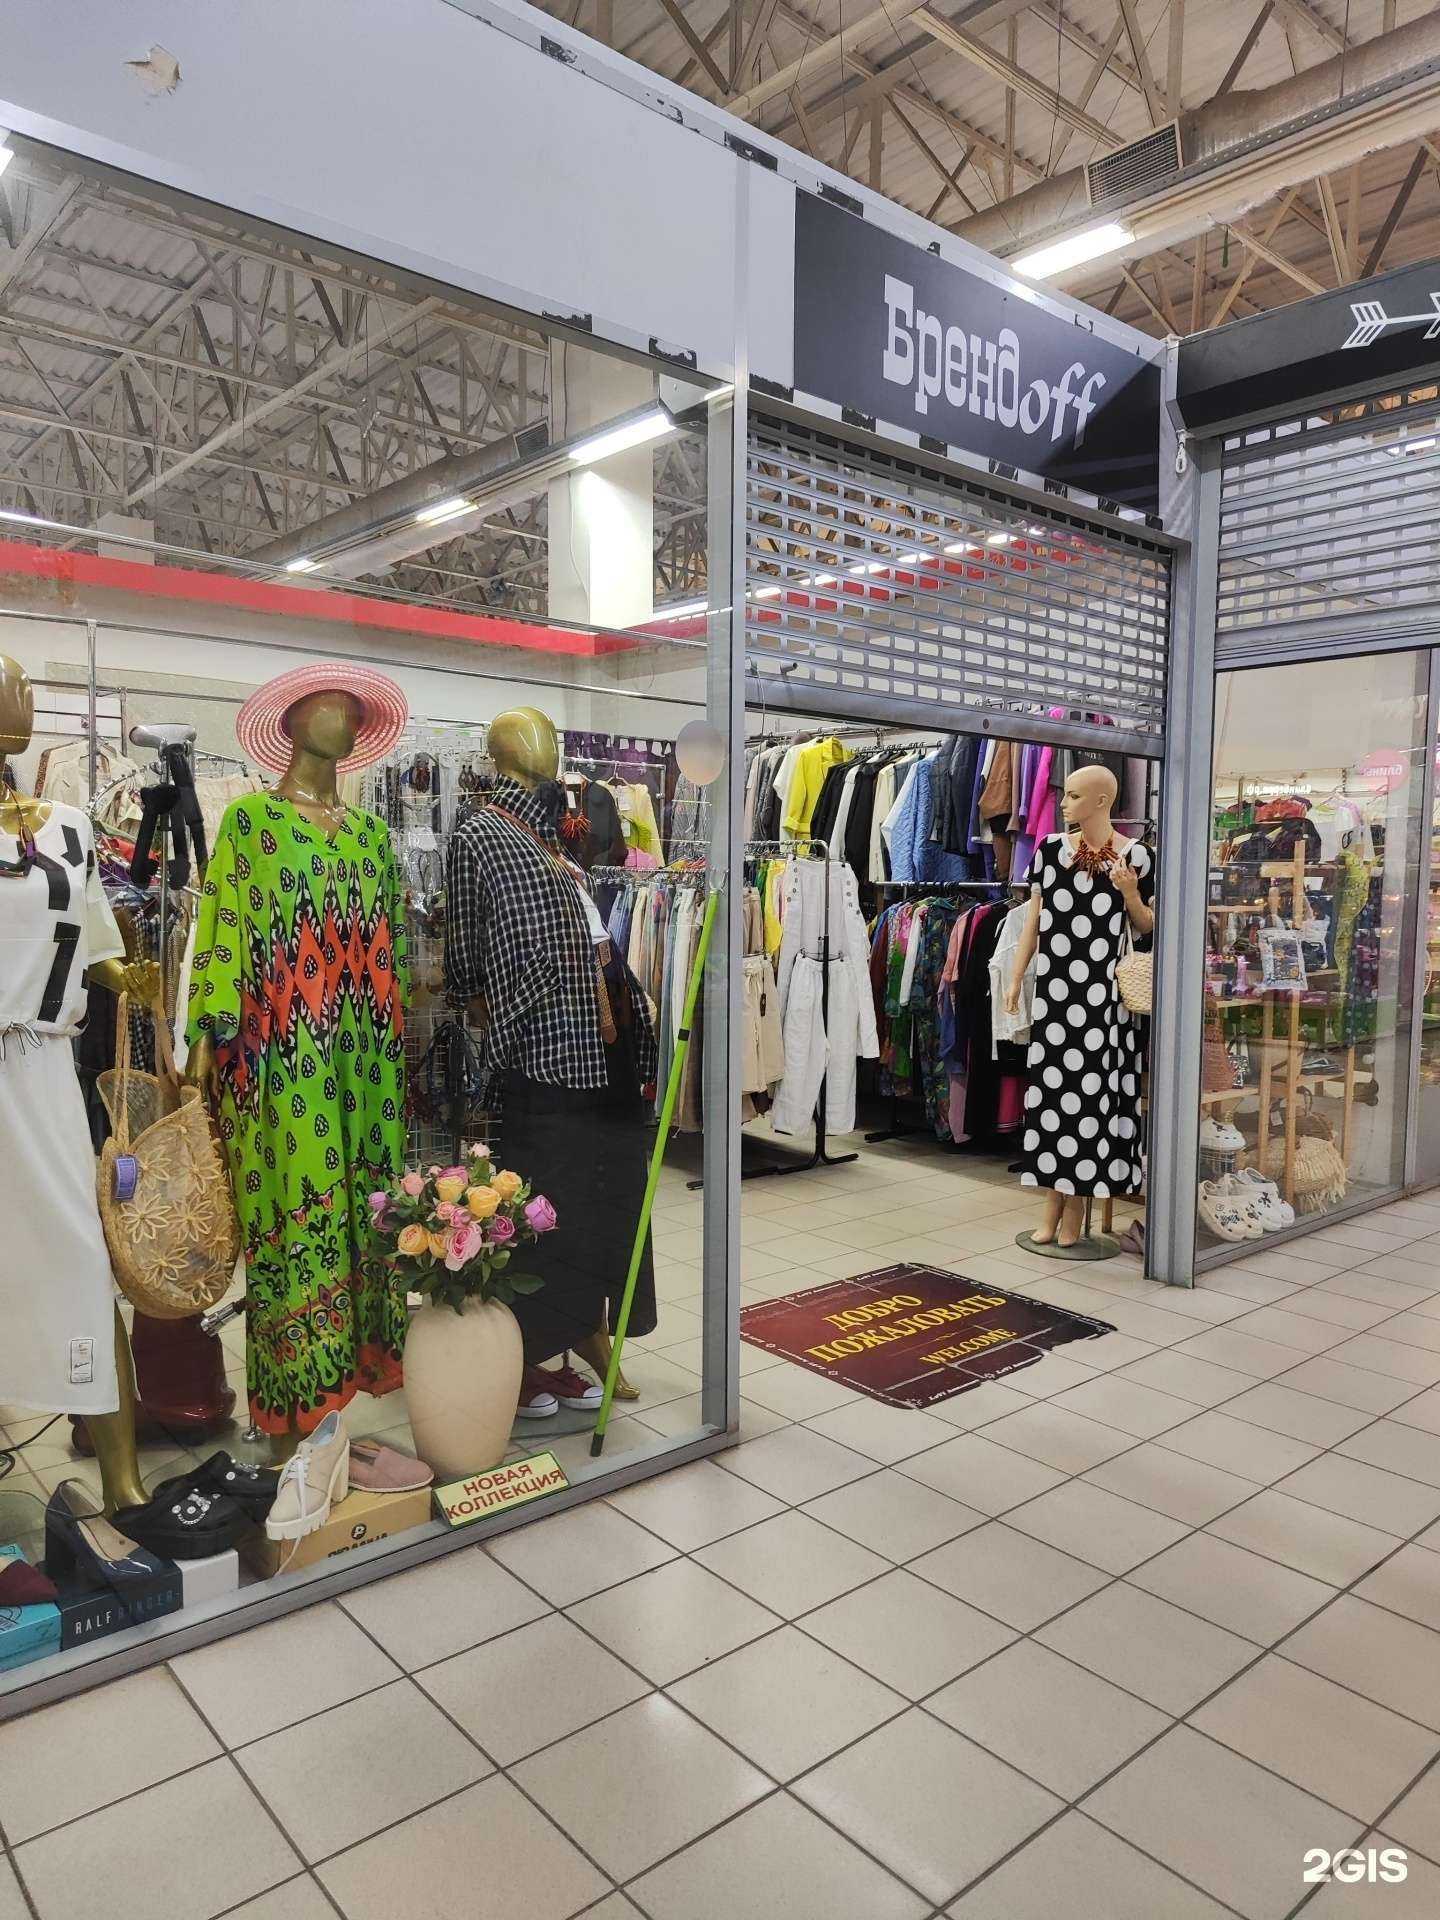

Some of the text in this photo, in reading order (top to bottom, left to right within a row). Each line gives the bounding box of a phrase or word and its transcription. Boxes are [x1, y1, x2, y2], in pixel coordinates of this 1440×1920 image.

[804, 1294, 1007, 1363] ПОЖАЛОВАТЬ
[822, 1295, 923, 1332] ДОБРО
[919, 1327, 1018, 1364] WELCOME
[446, 1469, 565, 1519] КОЛЛЕКЦИЯ
[463, 1464, 533, 1496] НОВАЯ
[74, 1609, 113, 1635] RALF
